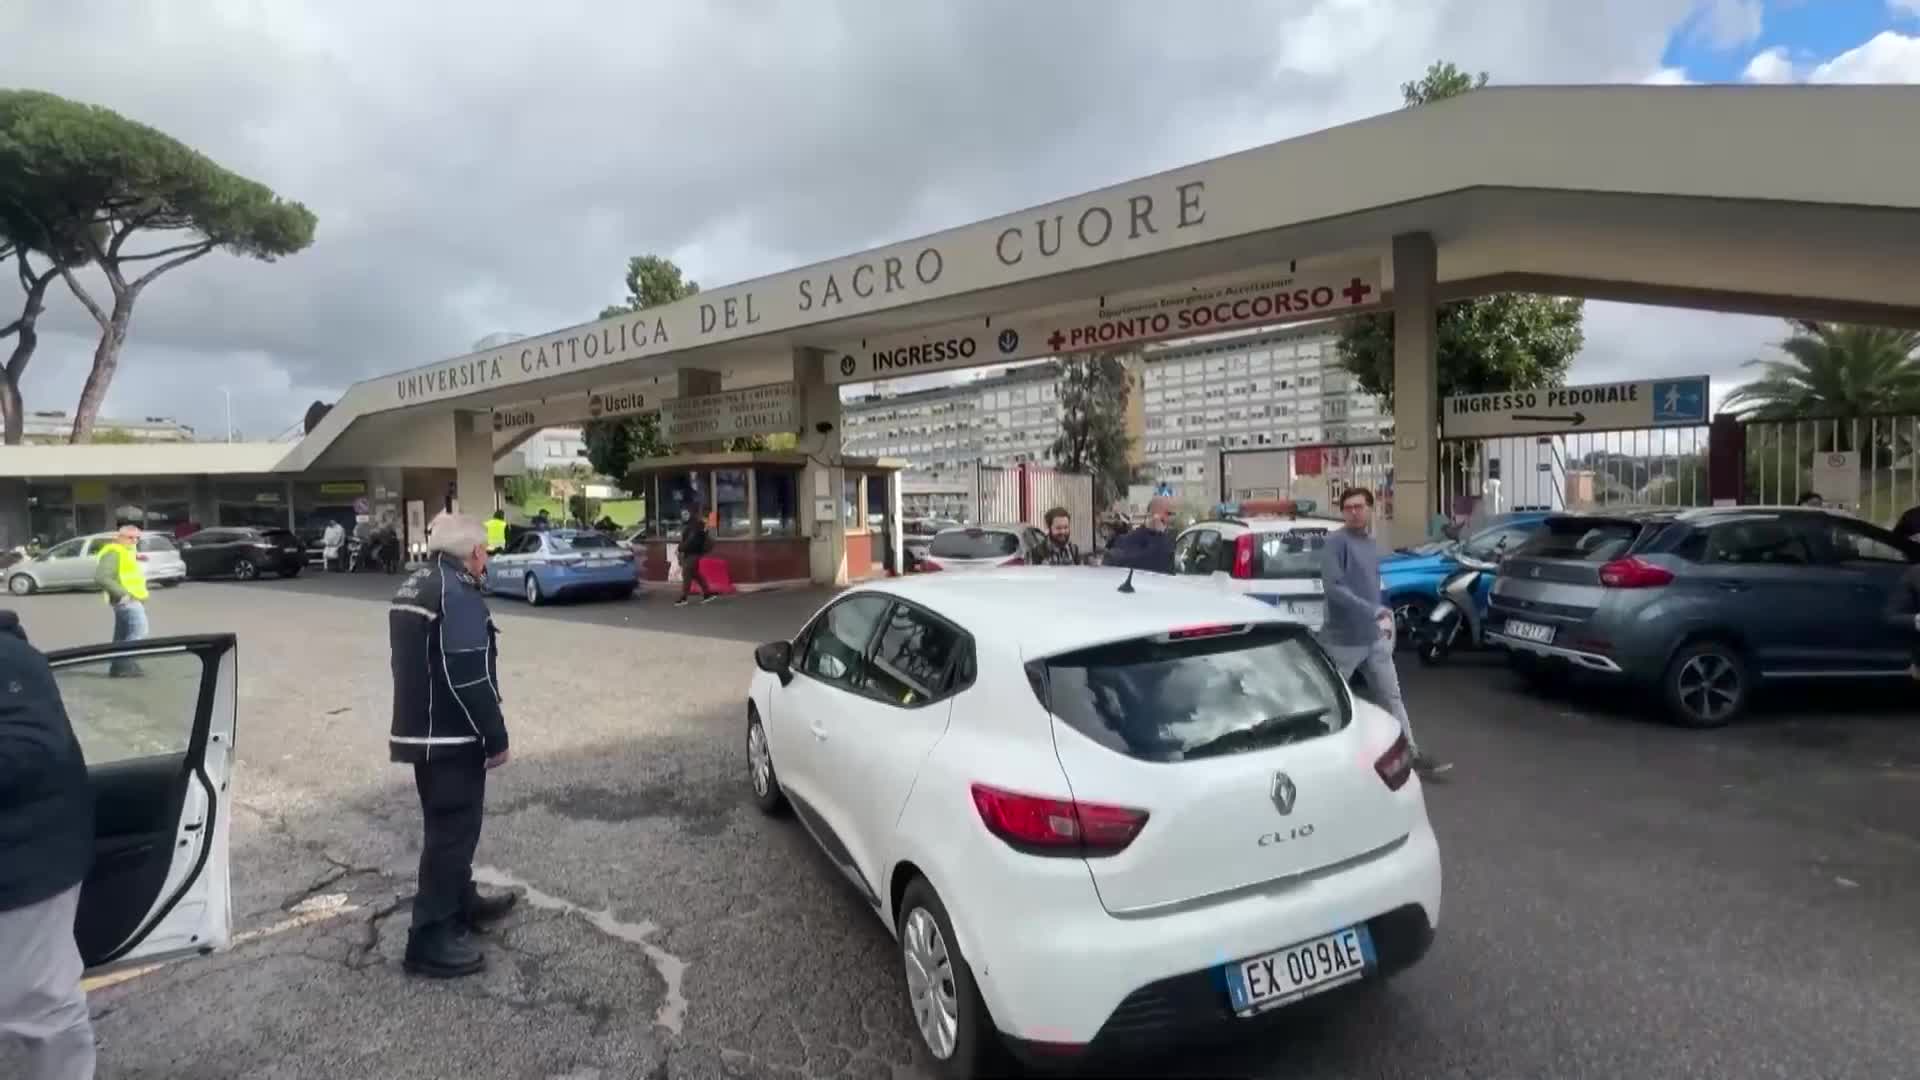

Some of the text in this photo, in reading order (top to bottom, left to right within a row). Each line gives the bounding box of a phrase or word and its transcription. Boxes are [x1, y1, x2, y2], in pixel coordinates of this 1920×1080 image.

[520, 316, 669, 373] CATTOLICA
[700, 293, 761, 334] DEL
[798, 248, 943, 311] SACRO
[996, 181, 1207, 266] CUORE
[1071, 285, 1334, 347] PRONTO SOCCORSO
[873, 337, 977, 372] INGRESSO
[604, 391, 645, 413] Uscita
[1453, 384, 1639, 415] INGRESSO PEDONALE
[503, 411, 536, 427] Uscita
[1257, 823, 1315, 847] CLIO
[1246, 932, 1361, 999] EX 009AE
